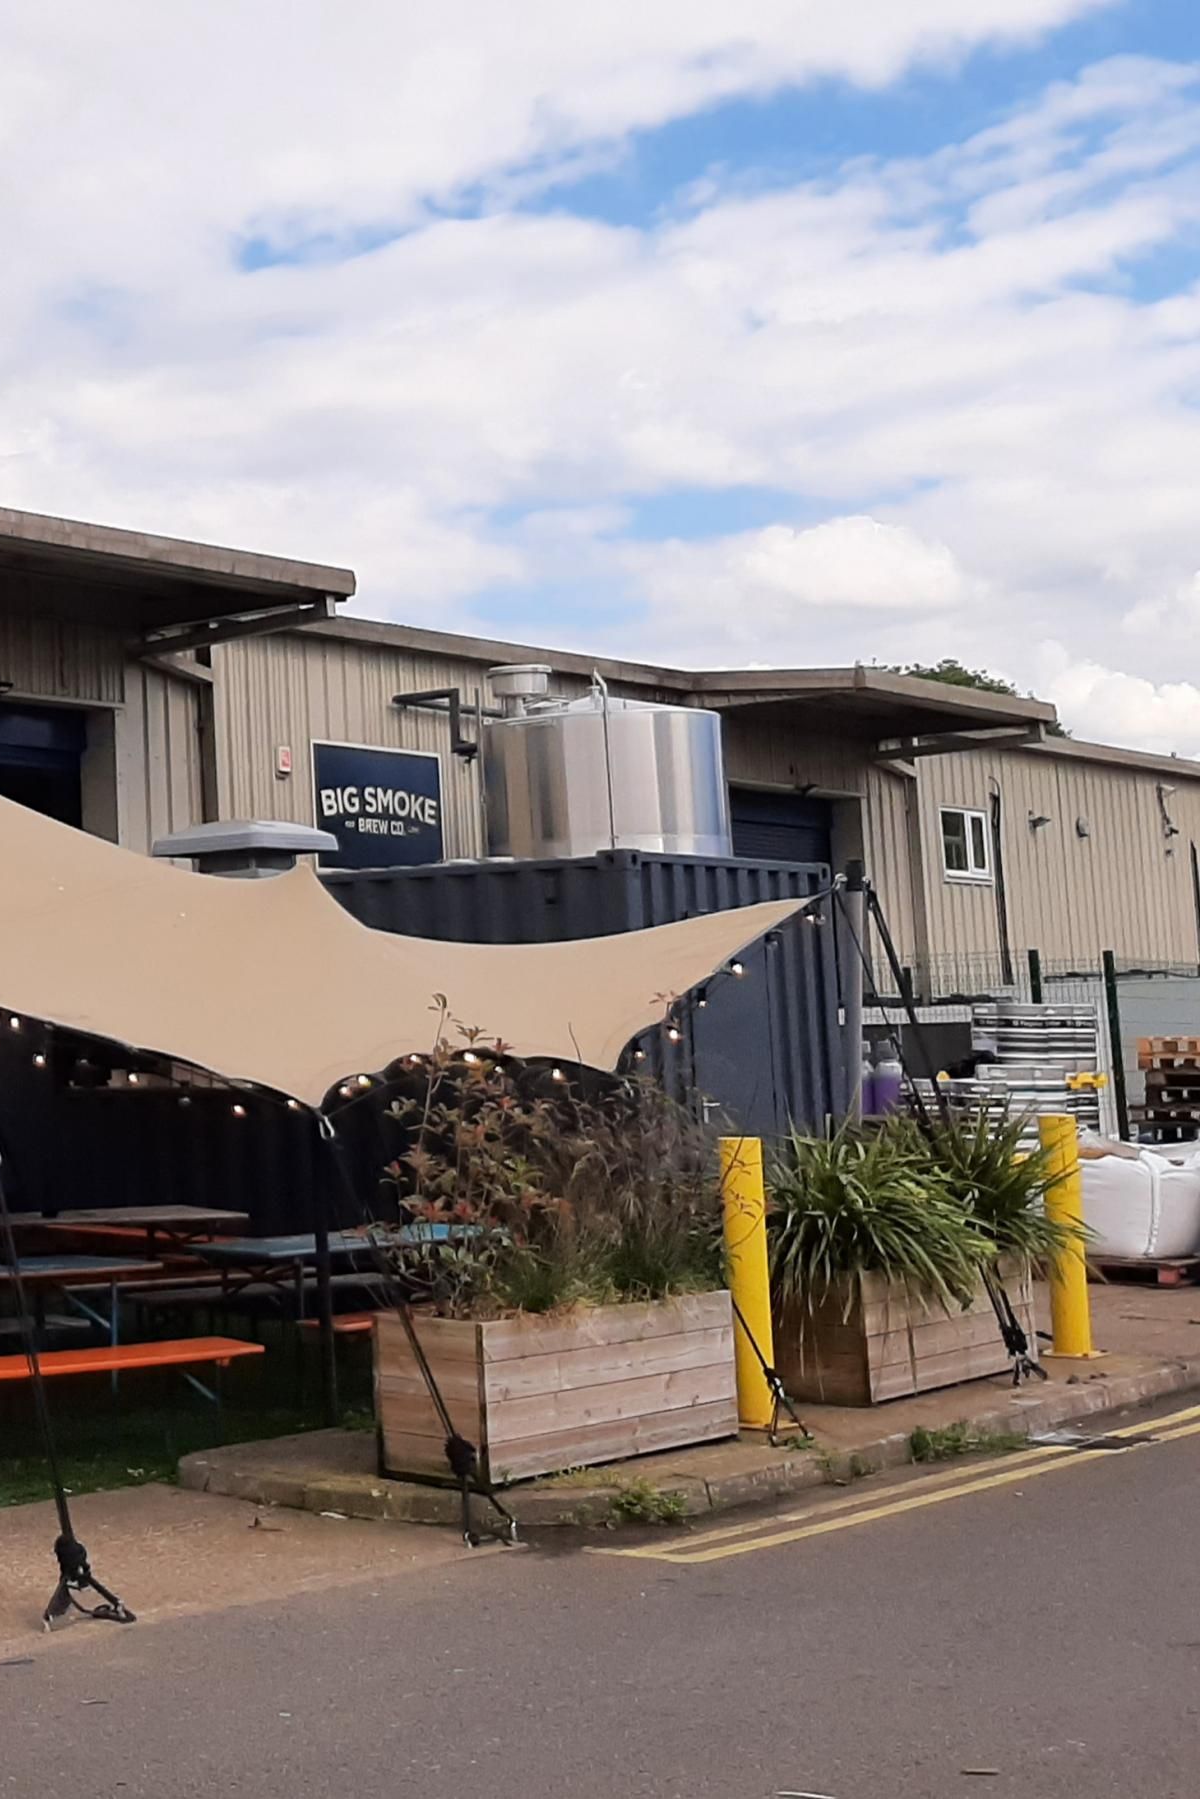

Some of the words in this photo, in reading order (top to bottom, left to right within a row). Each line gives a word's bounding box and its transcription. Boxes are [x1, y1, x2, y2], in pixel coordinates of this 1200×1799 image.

[320, 786, 360, 816] BIG
[364, 786, 437, 825] SMOKE
[358, 817, 388, 835] BREW
